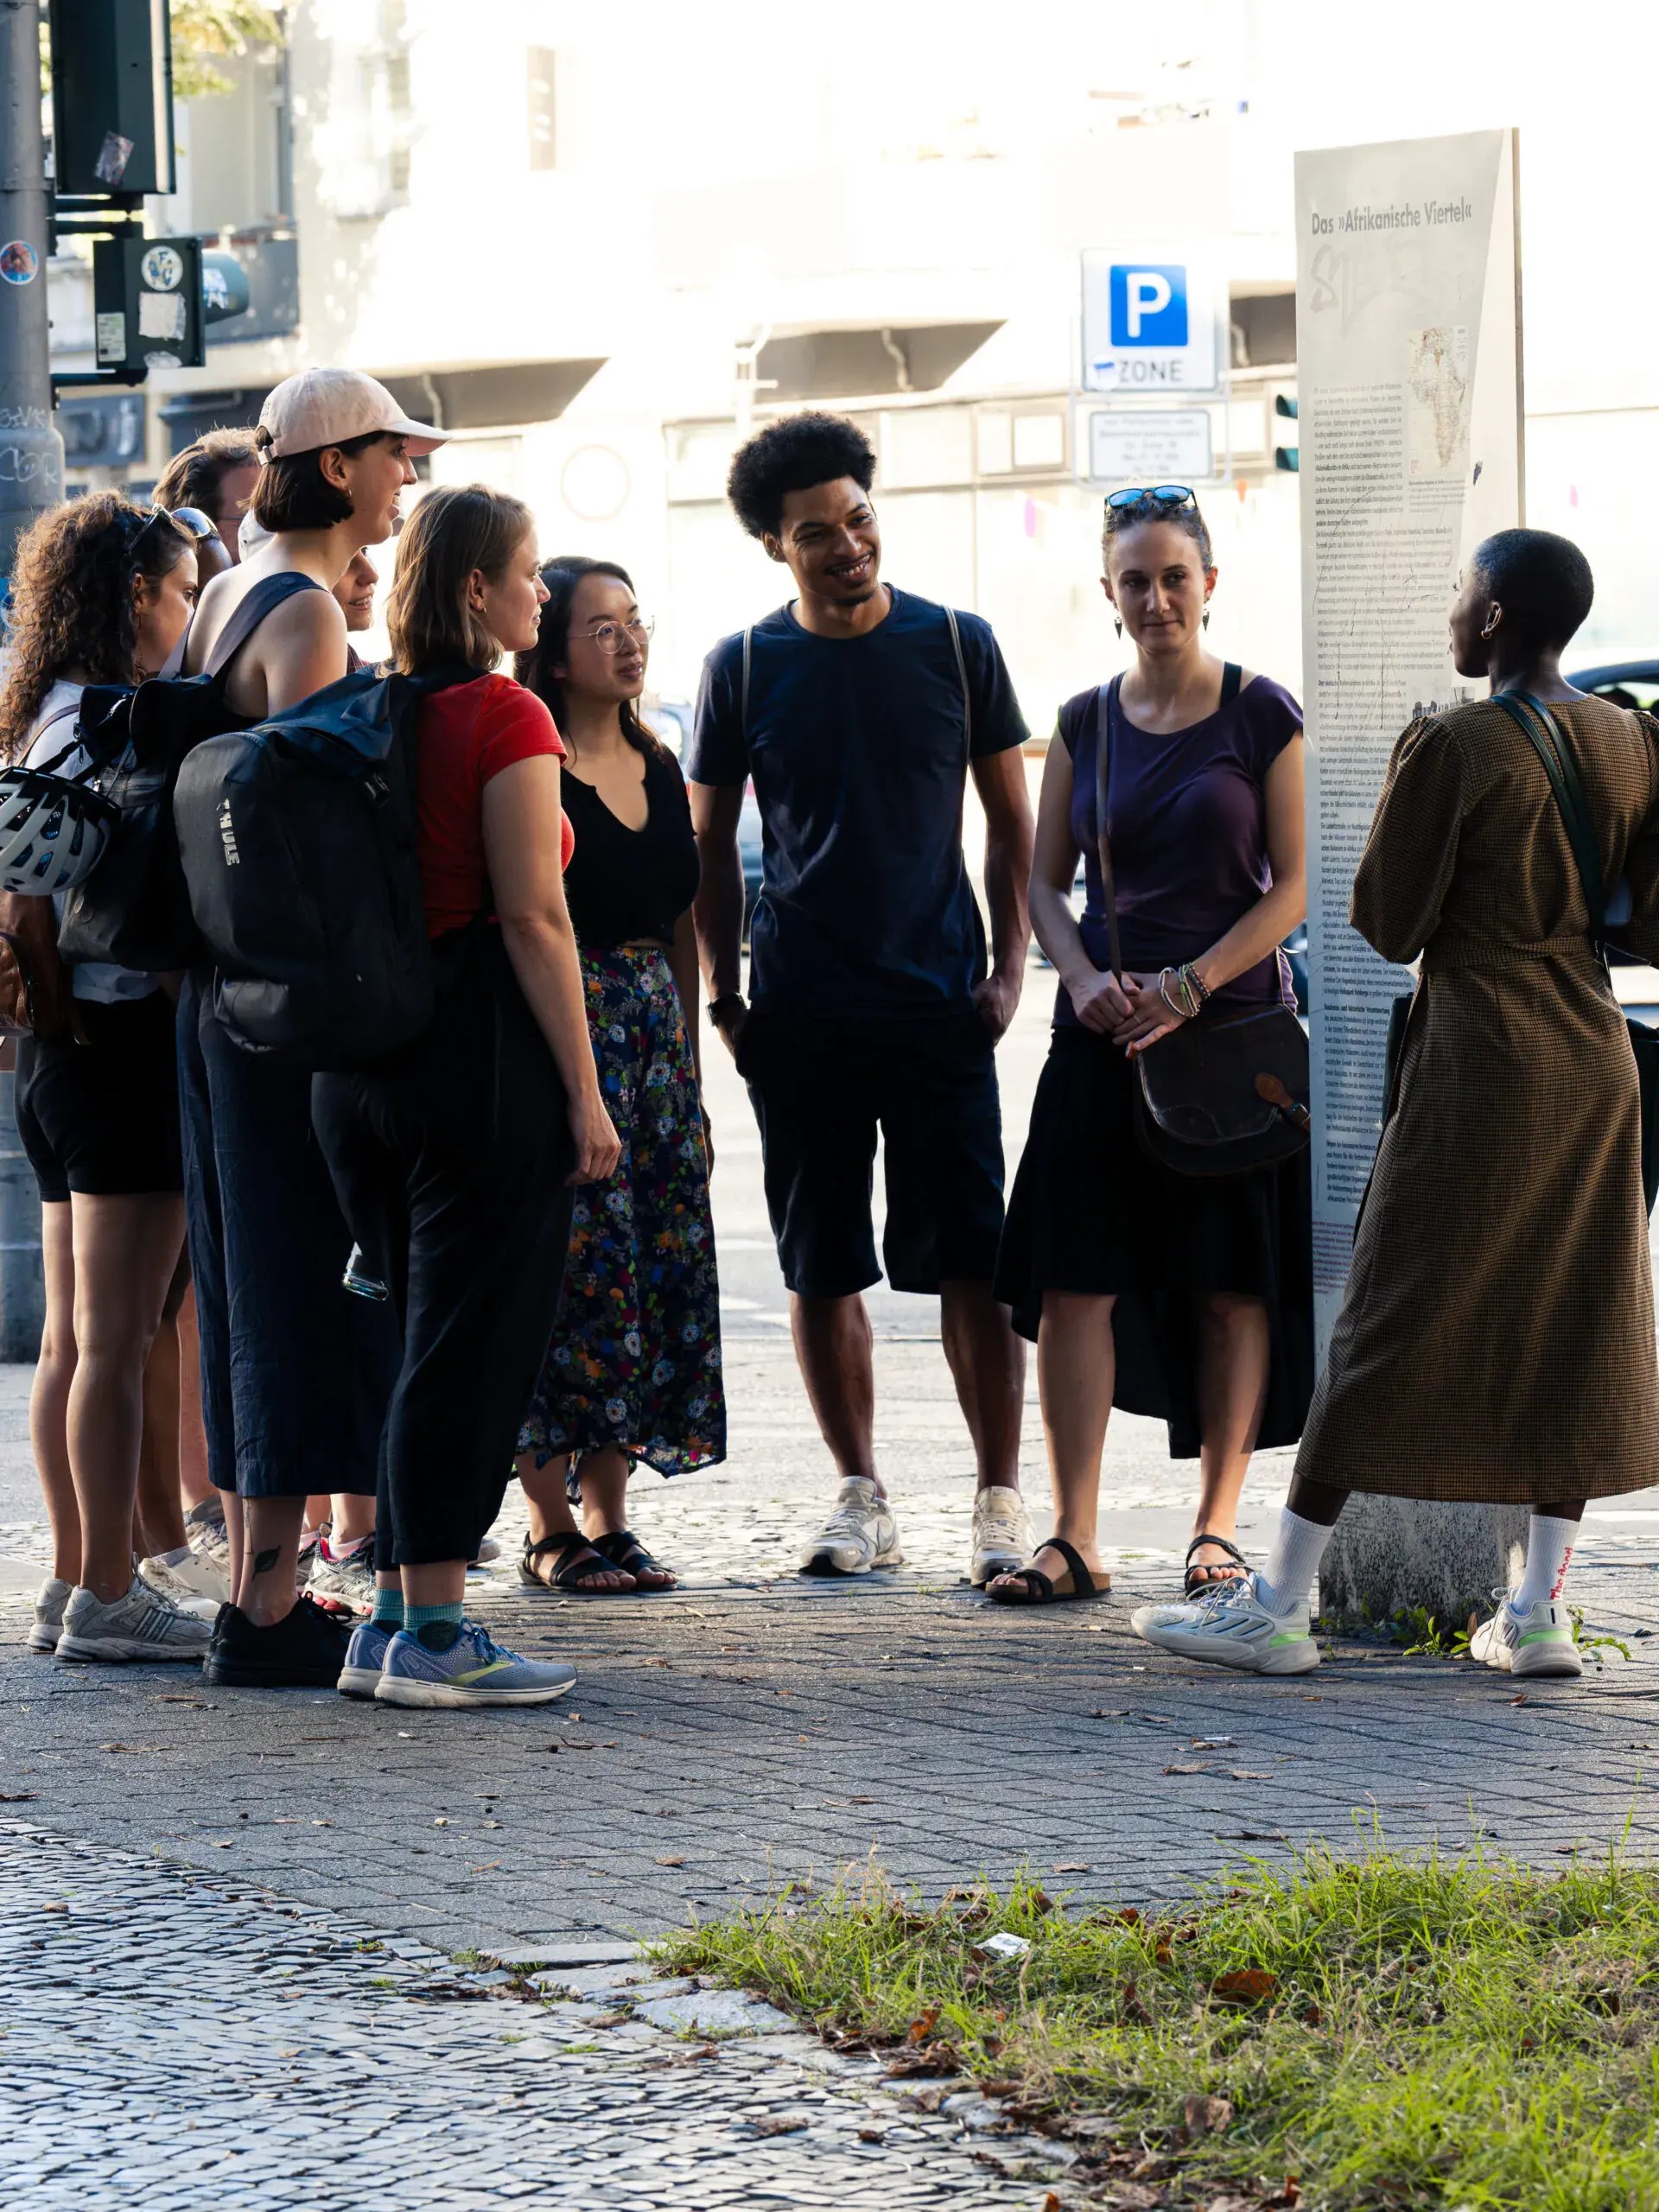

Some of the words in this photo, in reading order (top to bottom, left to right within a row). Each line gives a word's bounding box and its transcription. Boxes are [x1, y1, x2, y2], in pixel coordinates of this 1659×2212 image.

[1312, 213, 1334, 235] Das
[1338, 202, 1421, 232] »Afrikanische
[1424, 195, 1471, 226] Viertel«
[1126, 271, 1172, 339] P
[1118, 359, 1185, 383] ZONE
[216, 798, 241, 866] THULE
